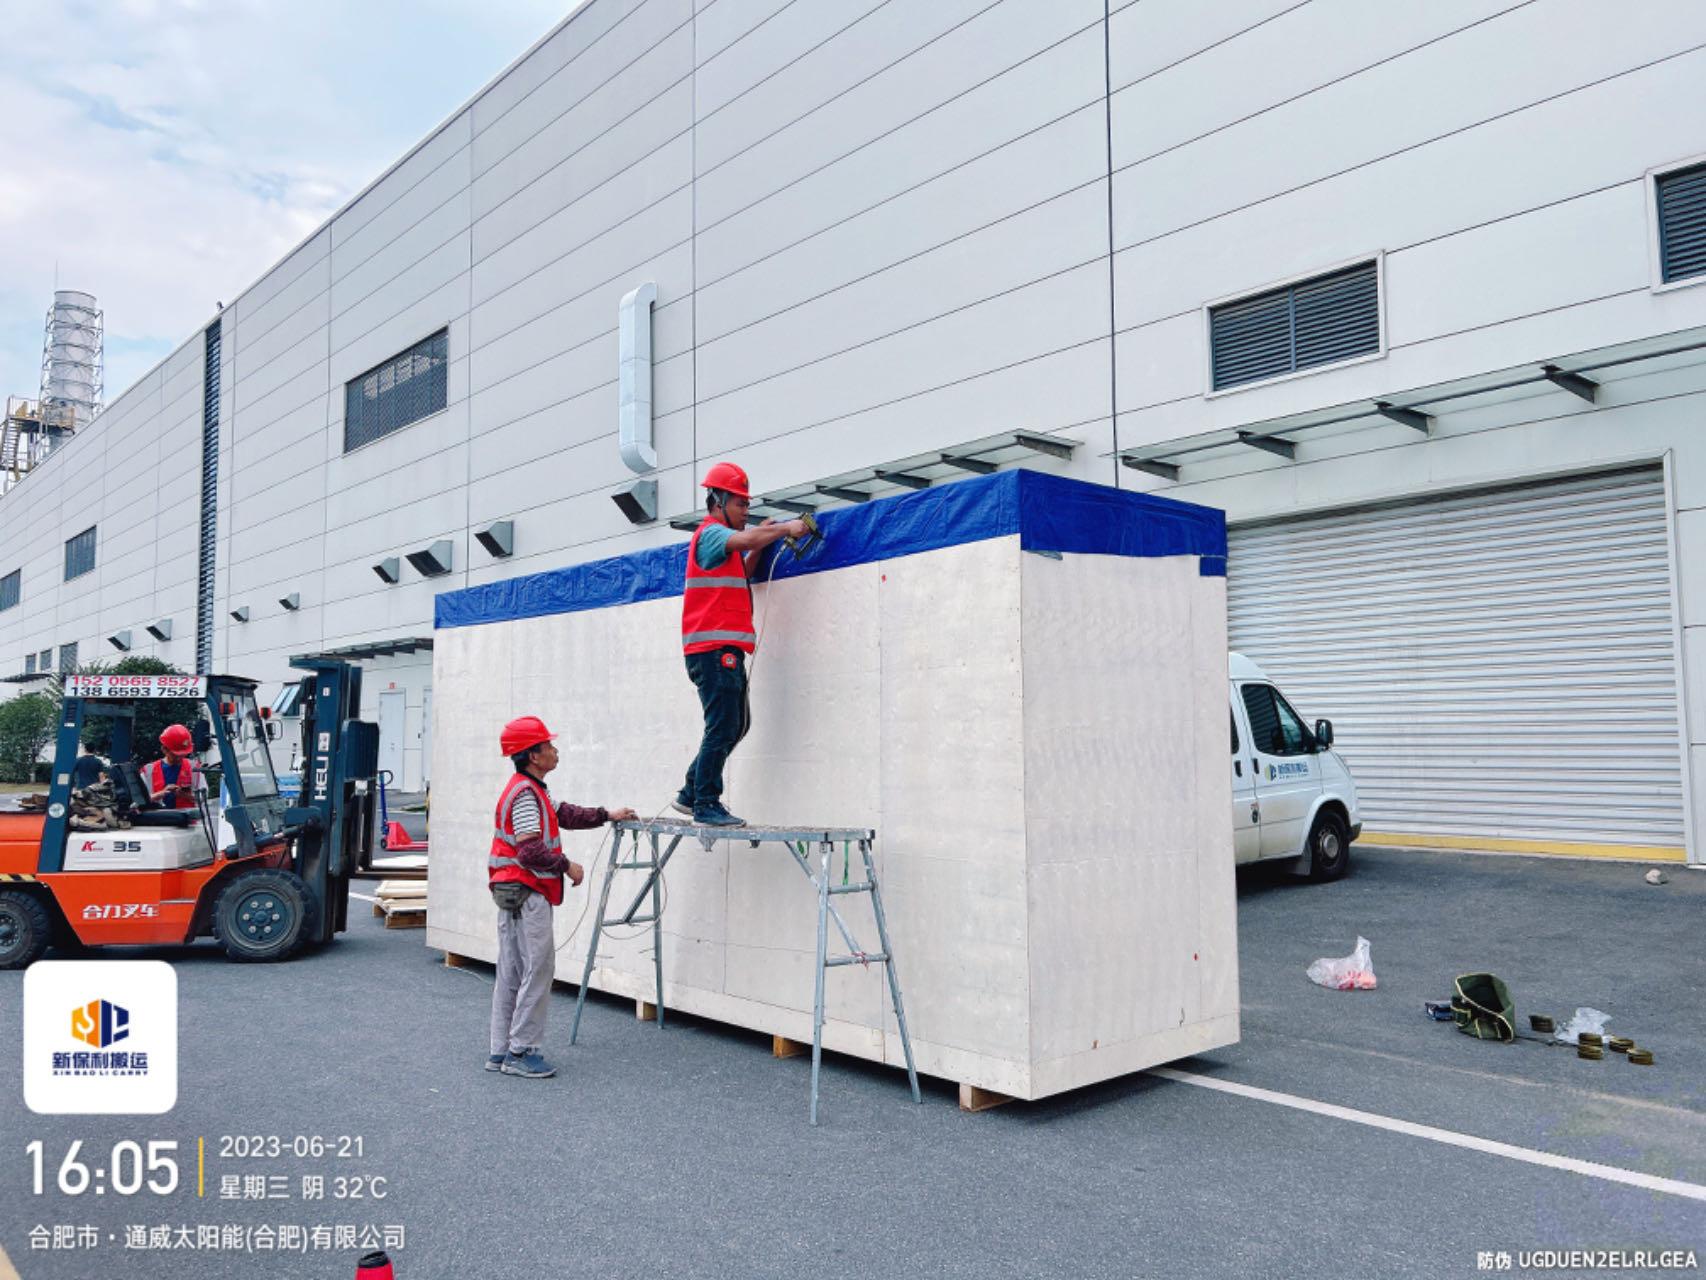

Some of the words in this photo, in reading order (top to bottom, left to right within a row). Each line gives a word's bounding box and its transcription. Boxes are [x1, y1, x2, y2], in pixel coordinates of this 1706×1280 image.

[72, 675, 103, 686] 152
[109, 676, 151, 686] 0565
[157, 676, 199, 686] 8527
[71, 687, 102, 696] 138
[108, 687, 150, 696] 6593
[157, 687, 199, 696] 7526
[314, 756, 329, 800] HELI
[113, 841, 142, 852] 35
[82, 904, 160, 919] 合力叉车
